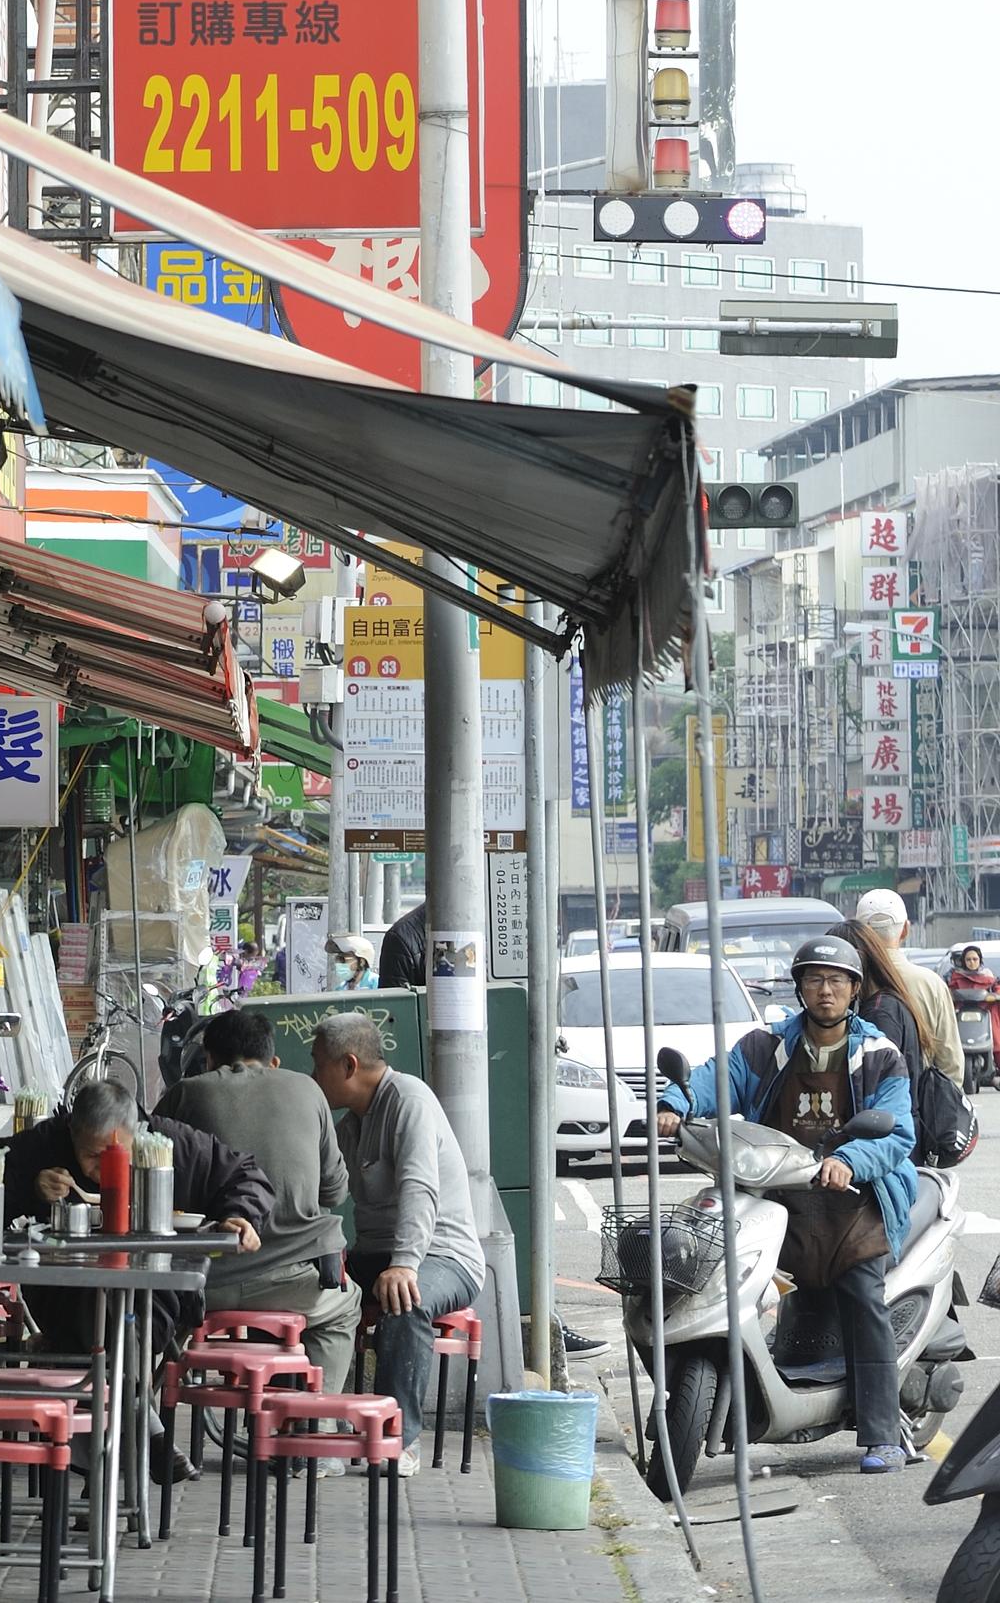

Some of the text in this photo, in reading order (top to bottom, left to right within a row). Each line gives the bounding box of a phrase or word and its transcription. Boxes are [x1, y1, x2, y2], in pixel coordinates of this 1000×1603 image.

[137, 0, 342, 47] 訂購專線
[157, 249, 207, 305] 品
[352, 661, 366, 678] 18
[381, 660, 397, 678] 33
[210, 908, 232, 932] 湯
